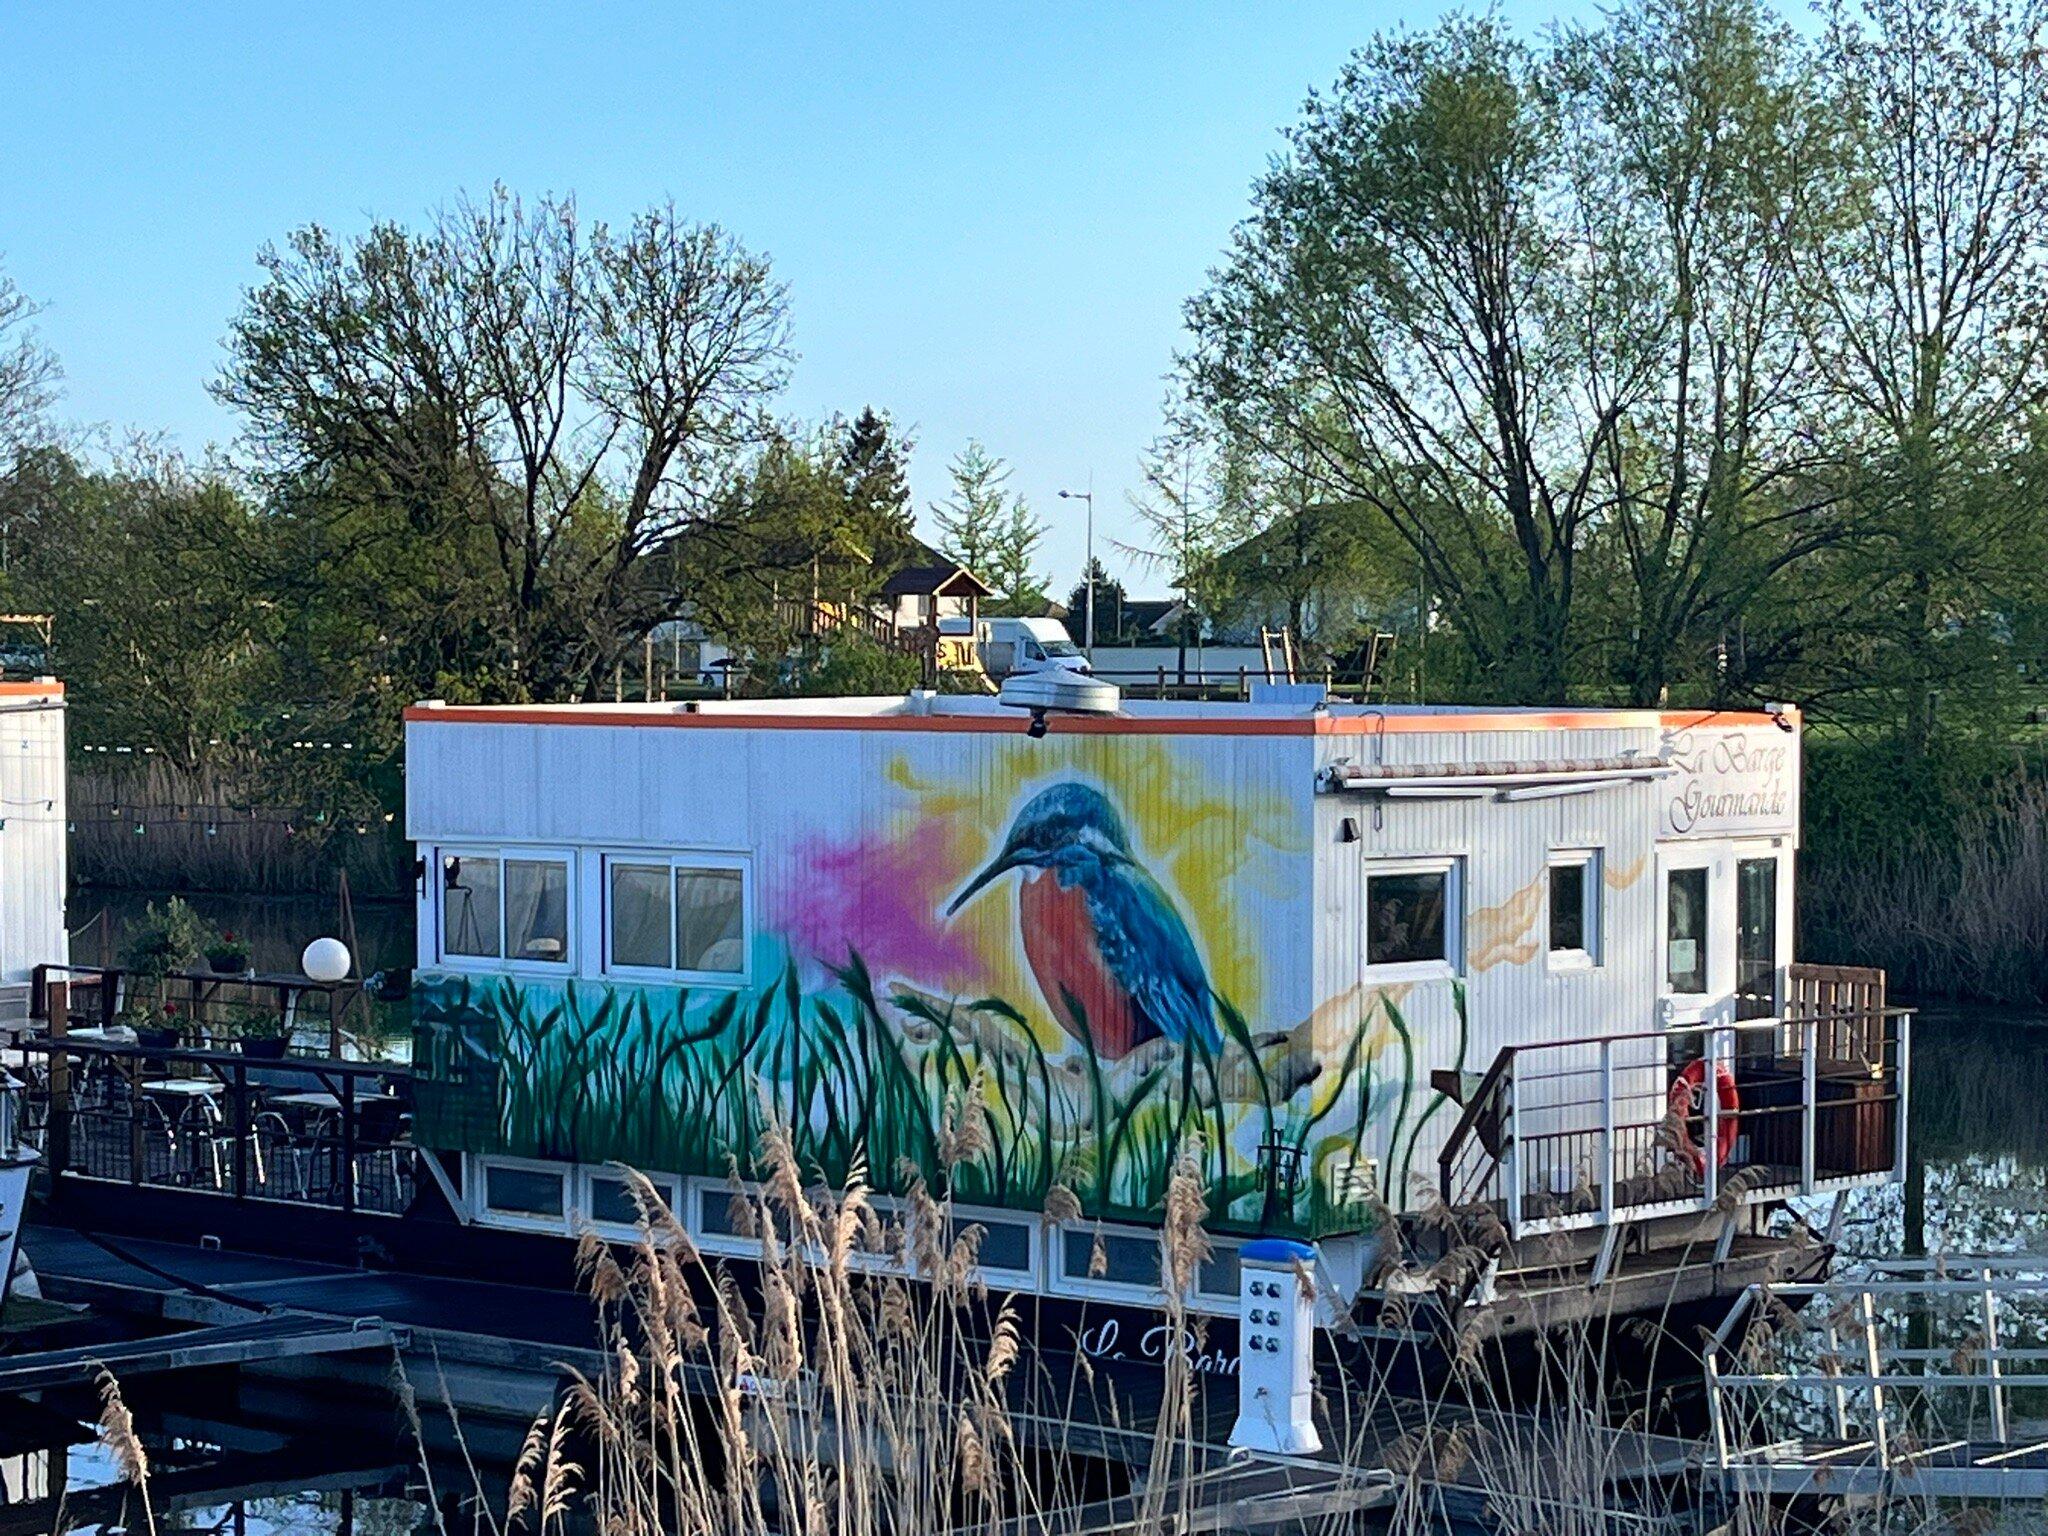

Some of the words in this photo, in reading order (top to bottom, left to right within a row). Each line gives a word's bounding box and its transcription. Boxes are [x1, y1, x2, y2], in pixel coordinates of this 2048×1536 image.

[1673, 732, 1709, 774] La
[1712, 732, 1787, 788] Barge
[1669, 778, 1788, 834] Gourmande
